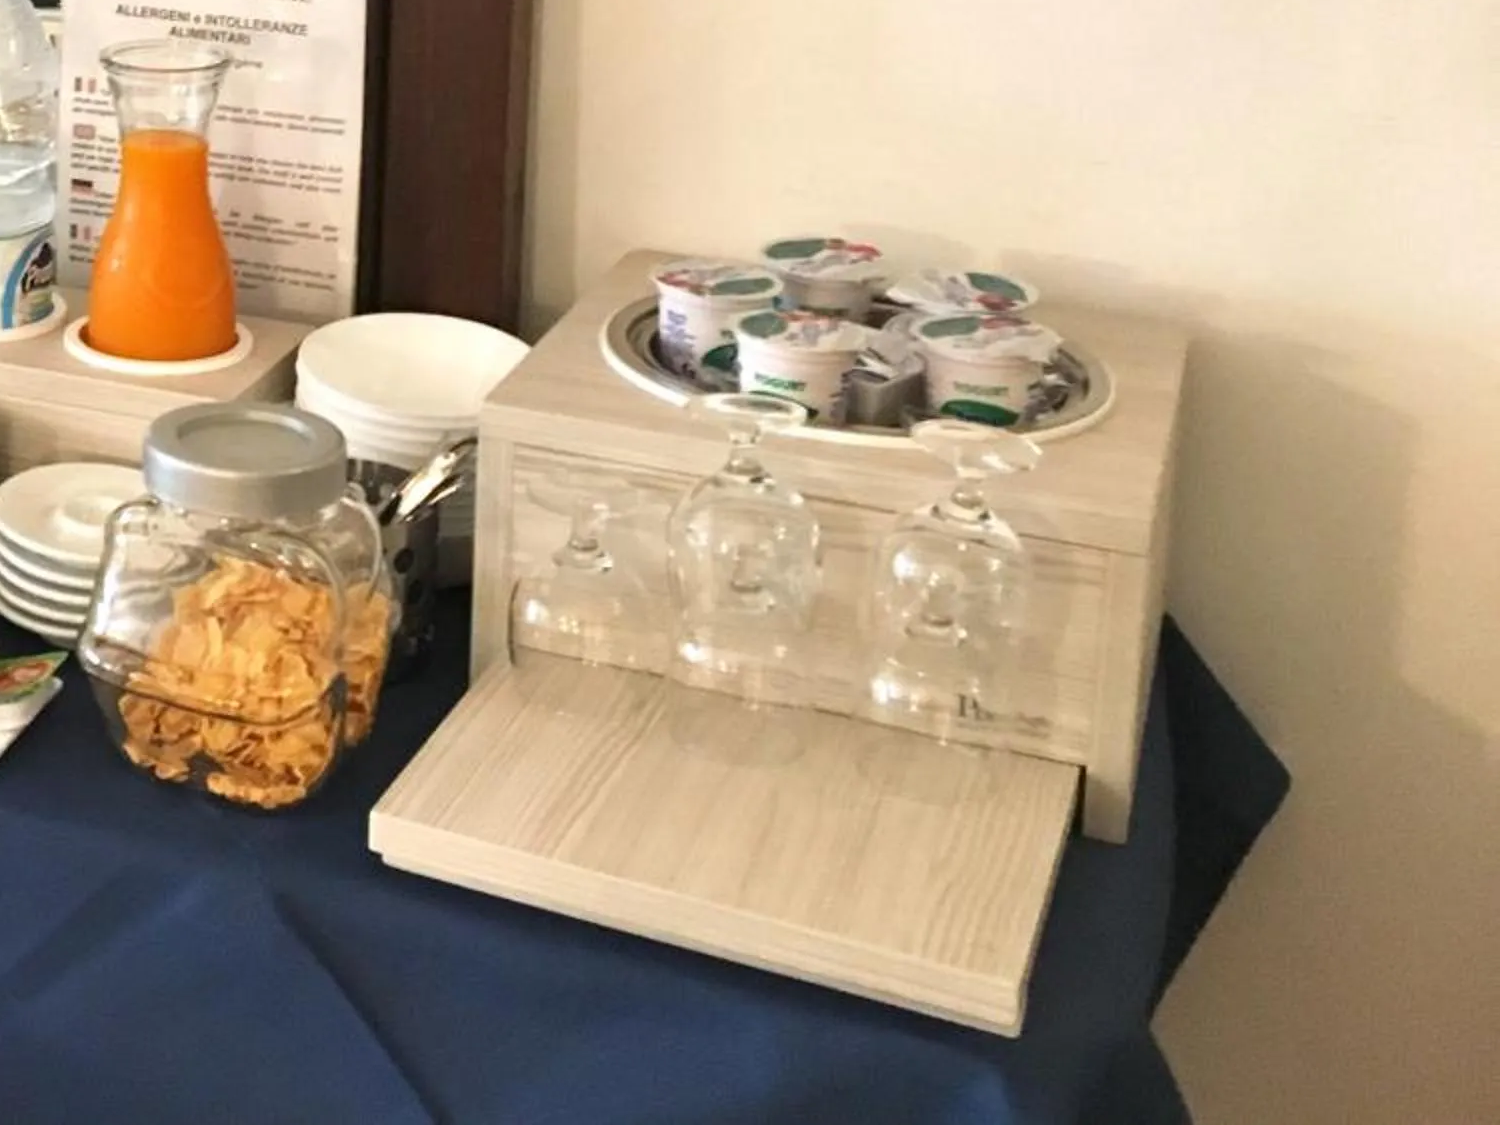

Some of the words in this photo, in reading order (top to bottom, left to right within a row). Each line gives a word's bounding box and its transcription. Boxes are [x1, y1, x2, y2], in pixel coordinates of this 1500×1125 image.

[115, 3, 191, 22] ALLERGENI
[204, 13, 308, 36] INTOLLERANZE
[169, 26, 251, 45] ALIMENTARI
